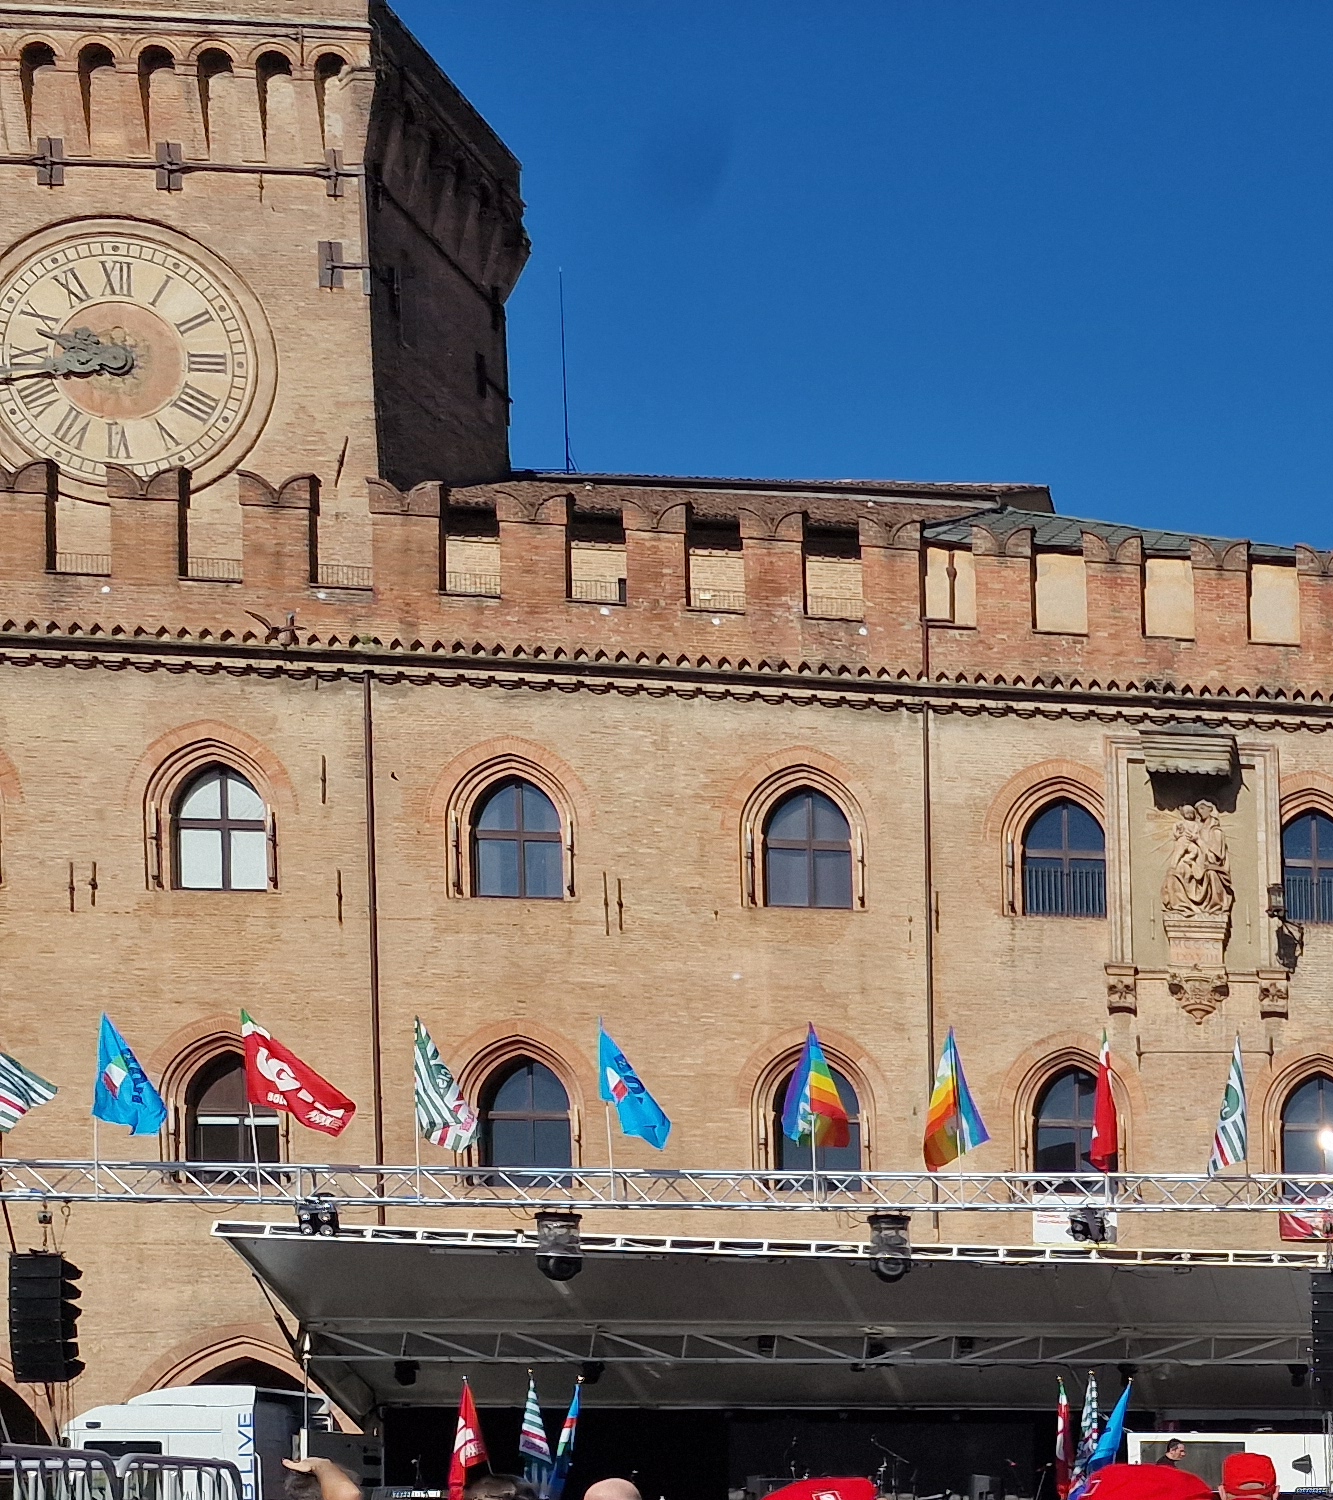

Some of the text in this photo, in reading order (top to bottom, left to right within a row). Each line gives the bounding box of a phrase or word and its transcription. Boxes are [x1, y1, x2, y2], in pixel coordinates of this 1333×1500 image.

[51, 267, 93, 309] XI
[99, 261, 133, 297] XII
[148, 274, 174, 307] I
[174, 308, 215, 336] II
[188, 352, 227, 375] III
[51, 405, 91, 450] VII
[106, 420, 133, 459] VI
[154, 418, 182, 451] V
